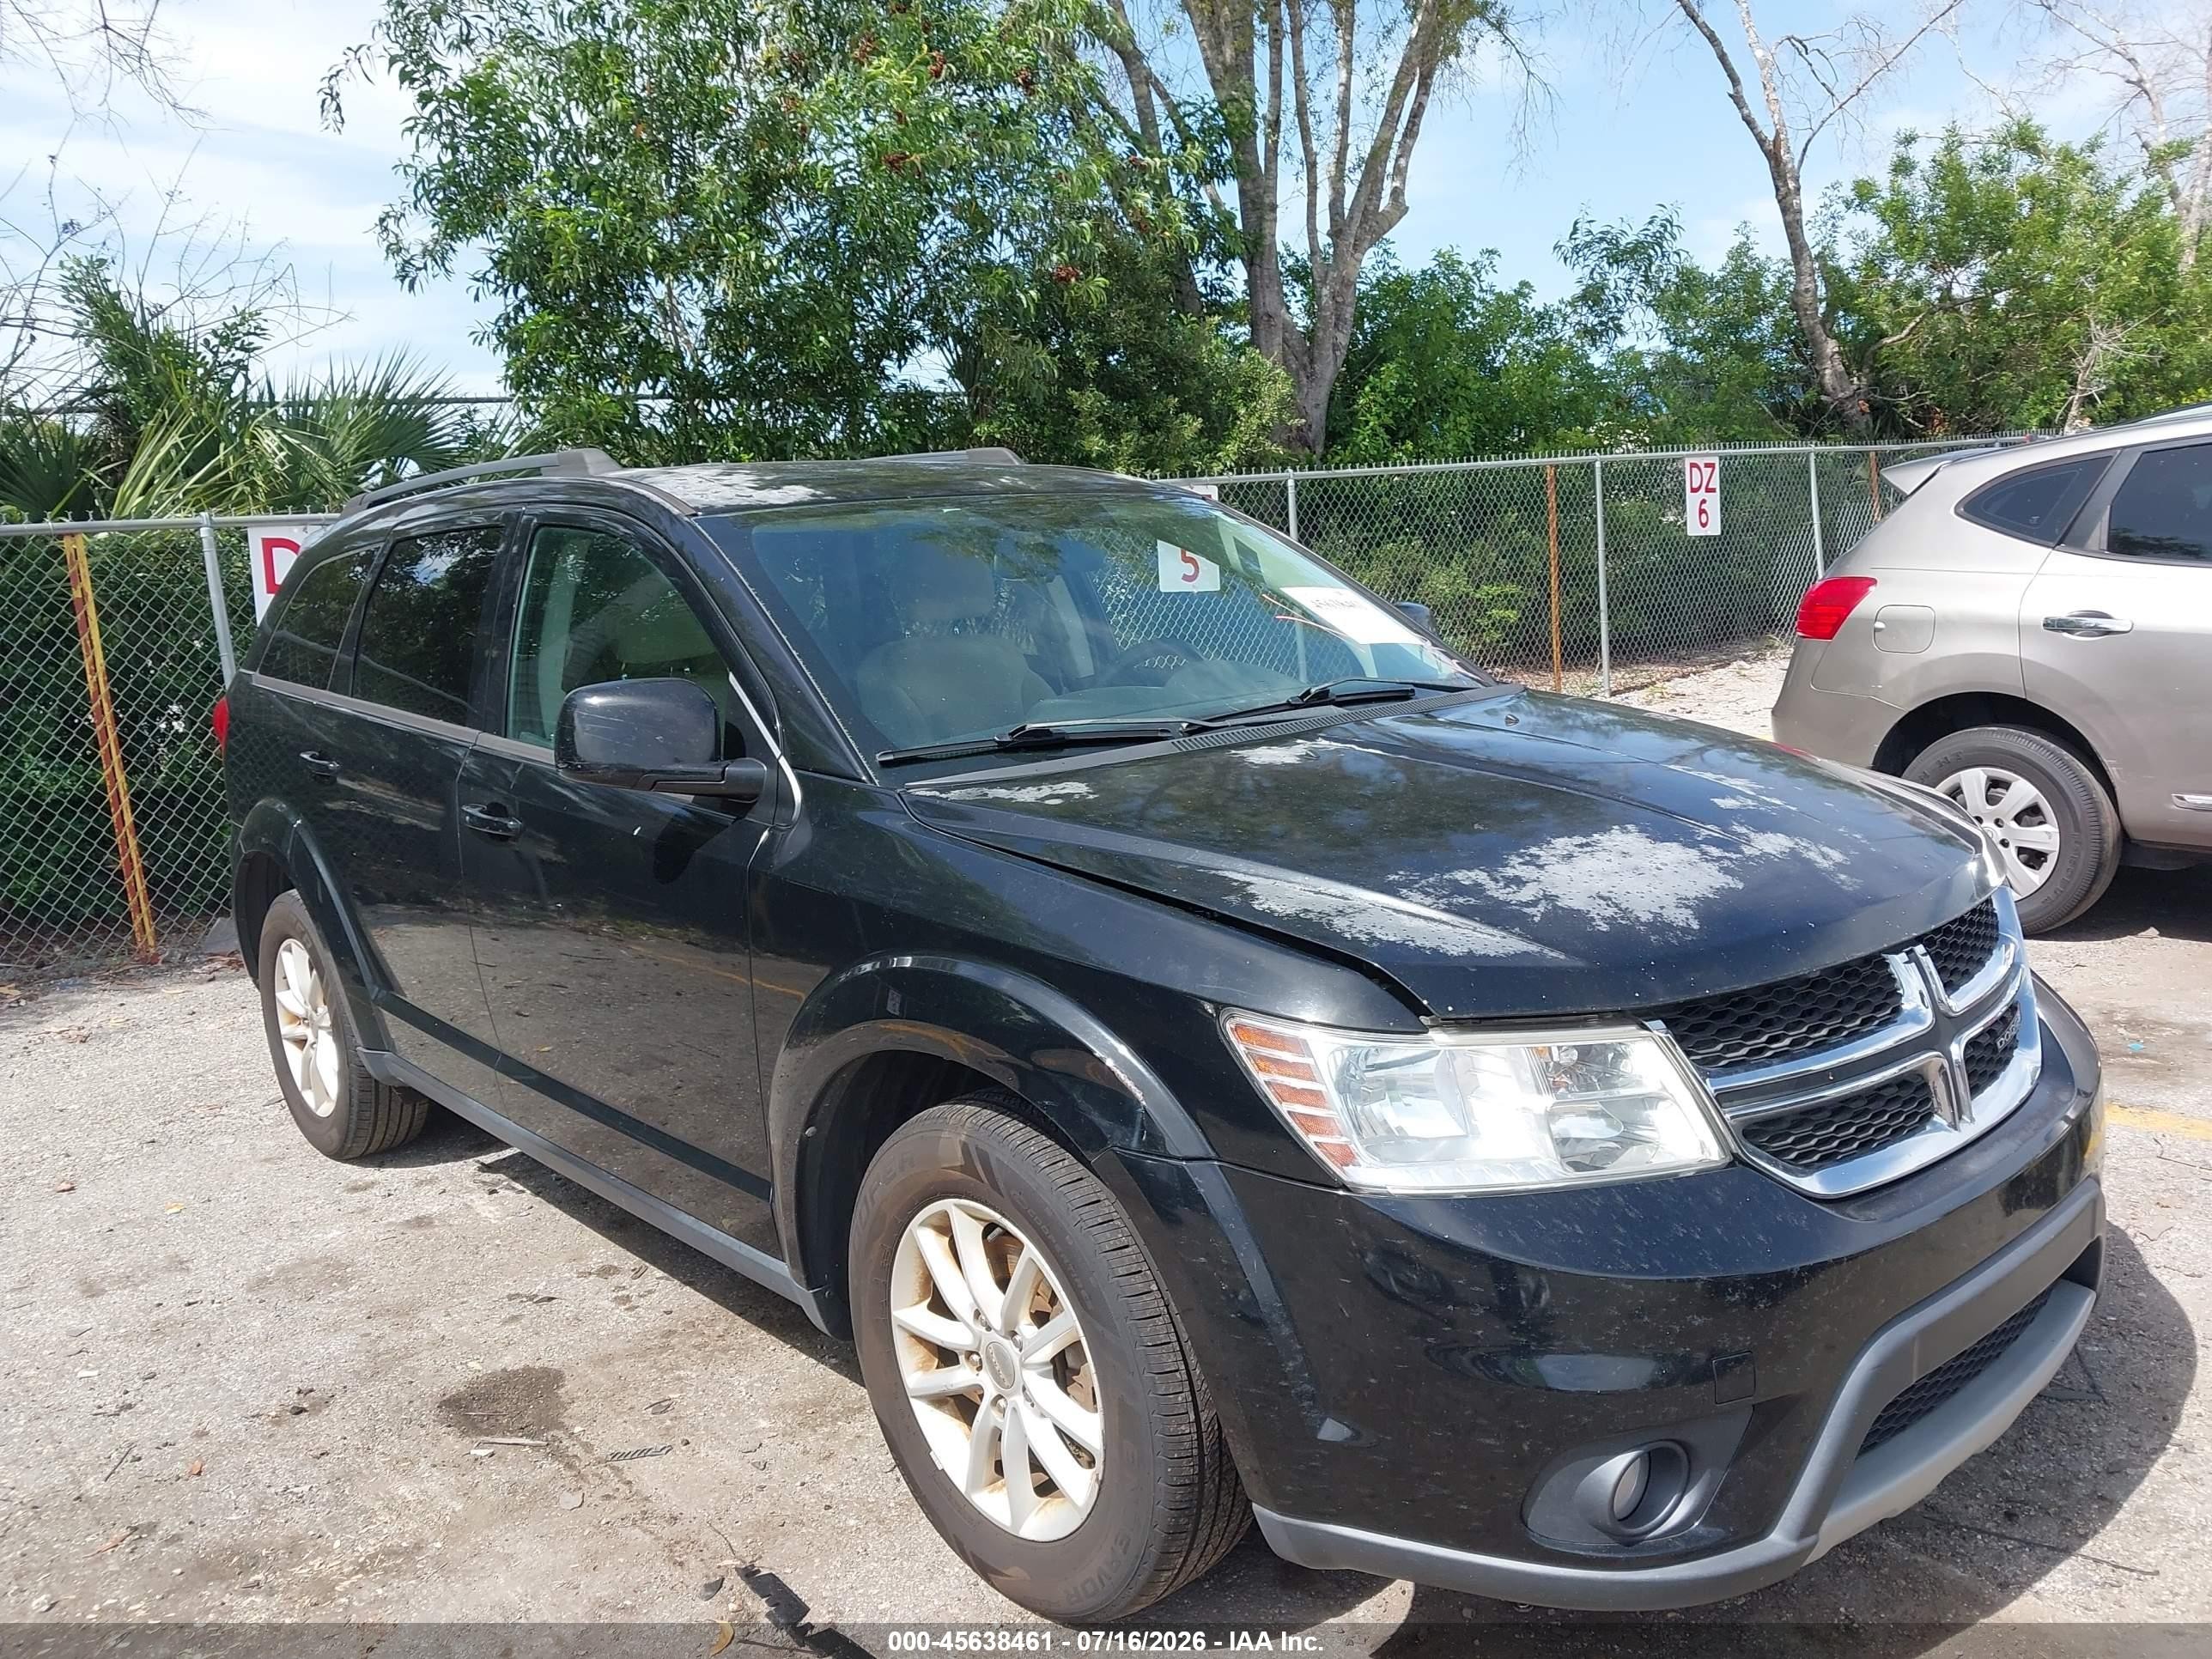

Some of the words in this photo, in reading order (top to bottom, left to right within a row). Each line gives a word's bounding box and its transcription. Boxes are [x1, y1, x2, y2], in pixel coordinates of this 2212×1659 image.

[1689, 462, 1717, 493] DZ
[1698, 498, 1709, 528] 6
[1181, 549, 1200, 582] 5
